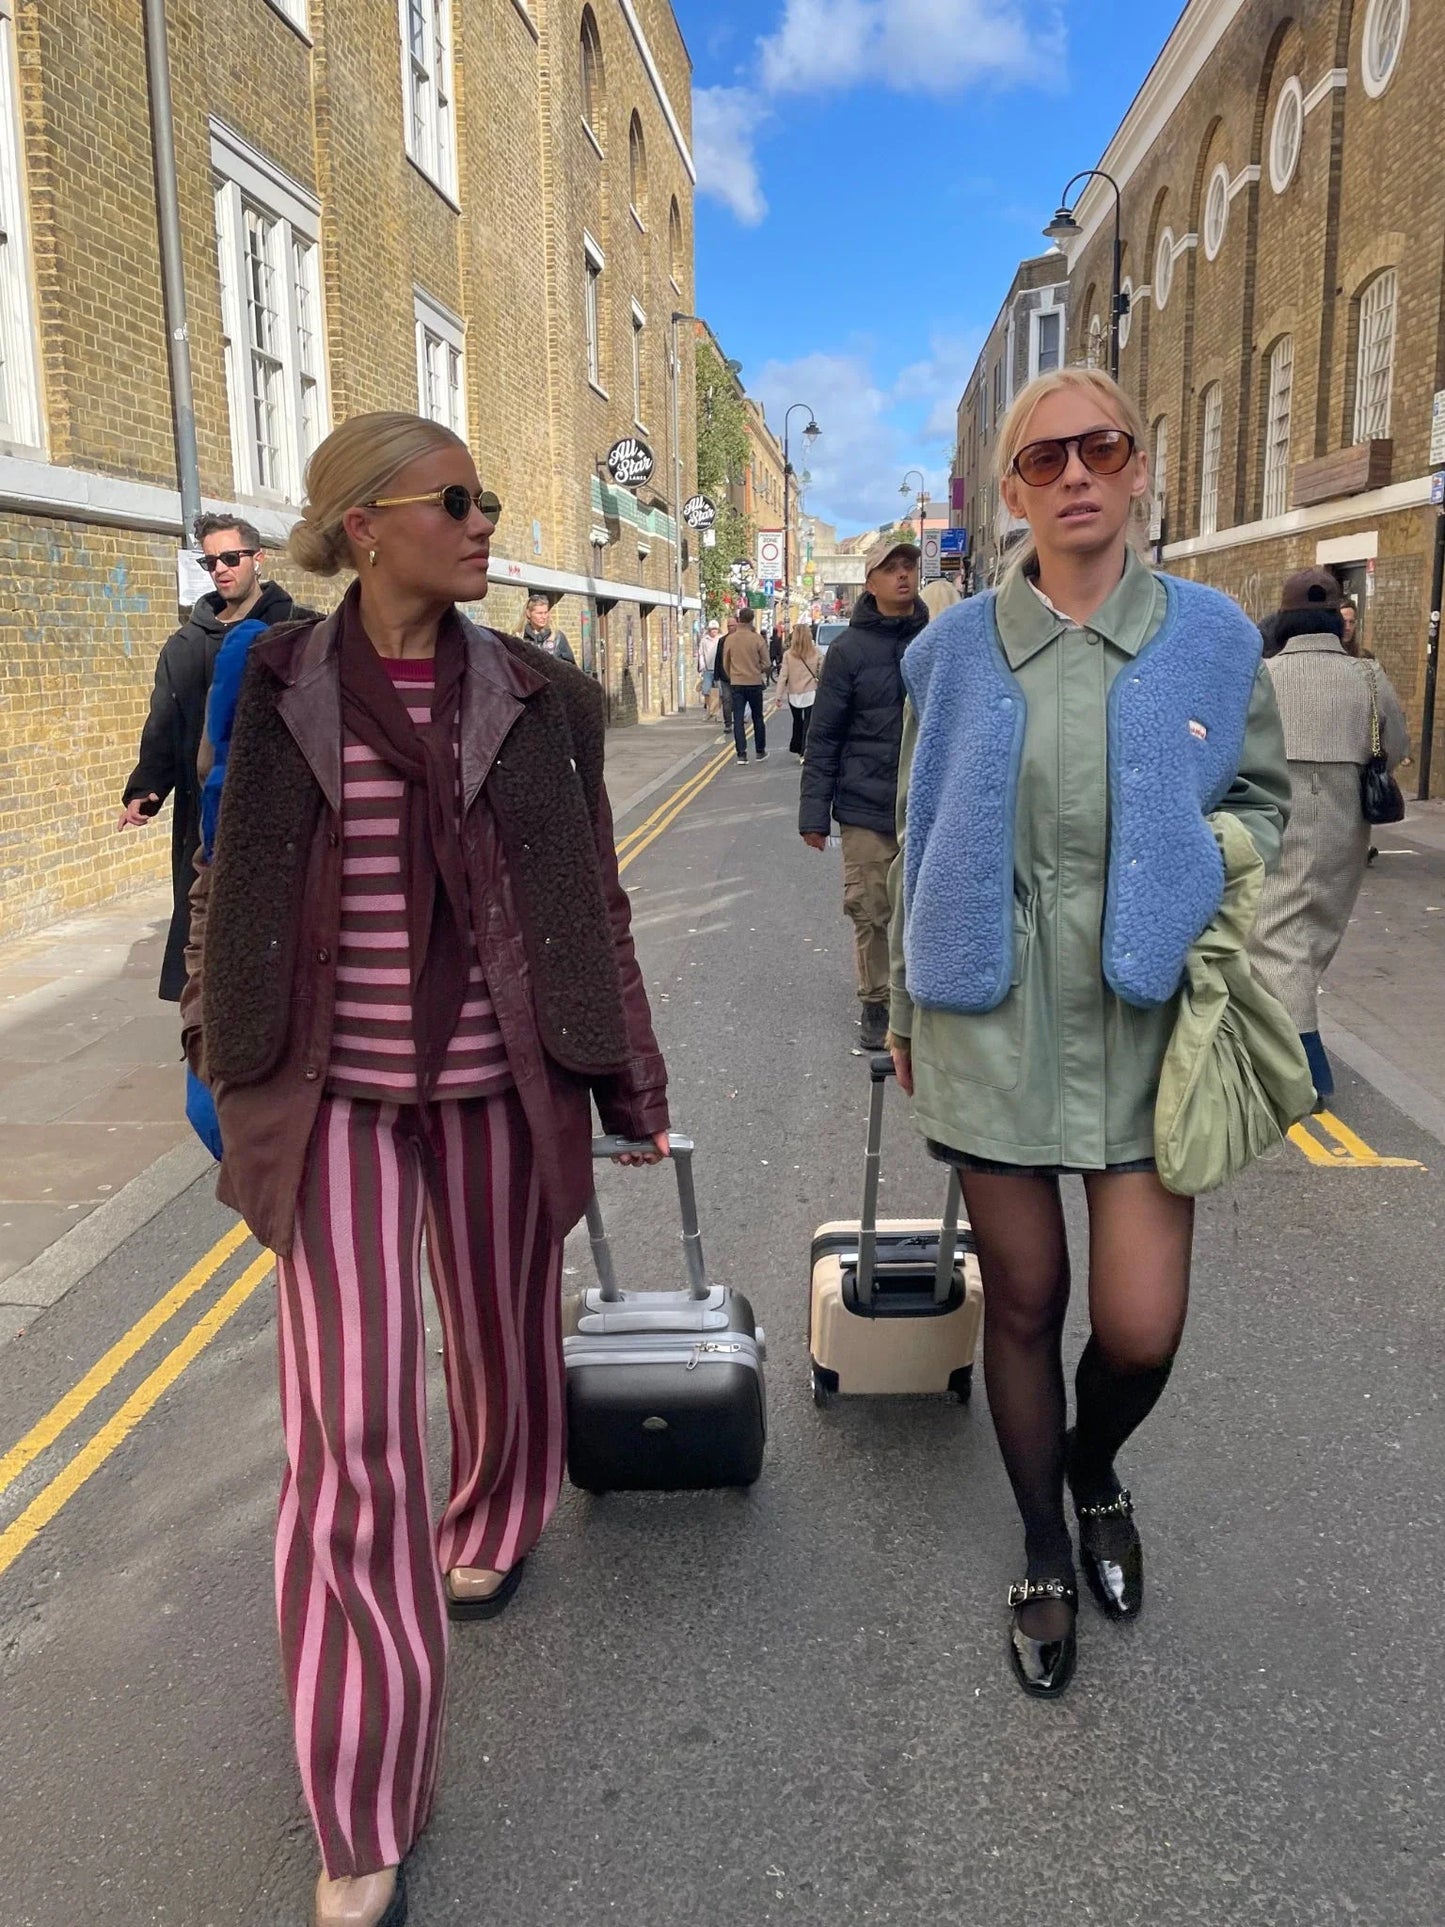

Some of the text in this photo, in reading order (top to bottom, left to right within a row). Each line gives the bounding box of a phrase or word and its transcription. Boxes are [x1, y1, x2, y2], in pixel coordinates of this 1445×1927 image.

[609, 438, 638, 466] All
[615, 456, 653, 483] Star
[683, 495, 706, 515] All
[688, 508, 715, 528] Star
